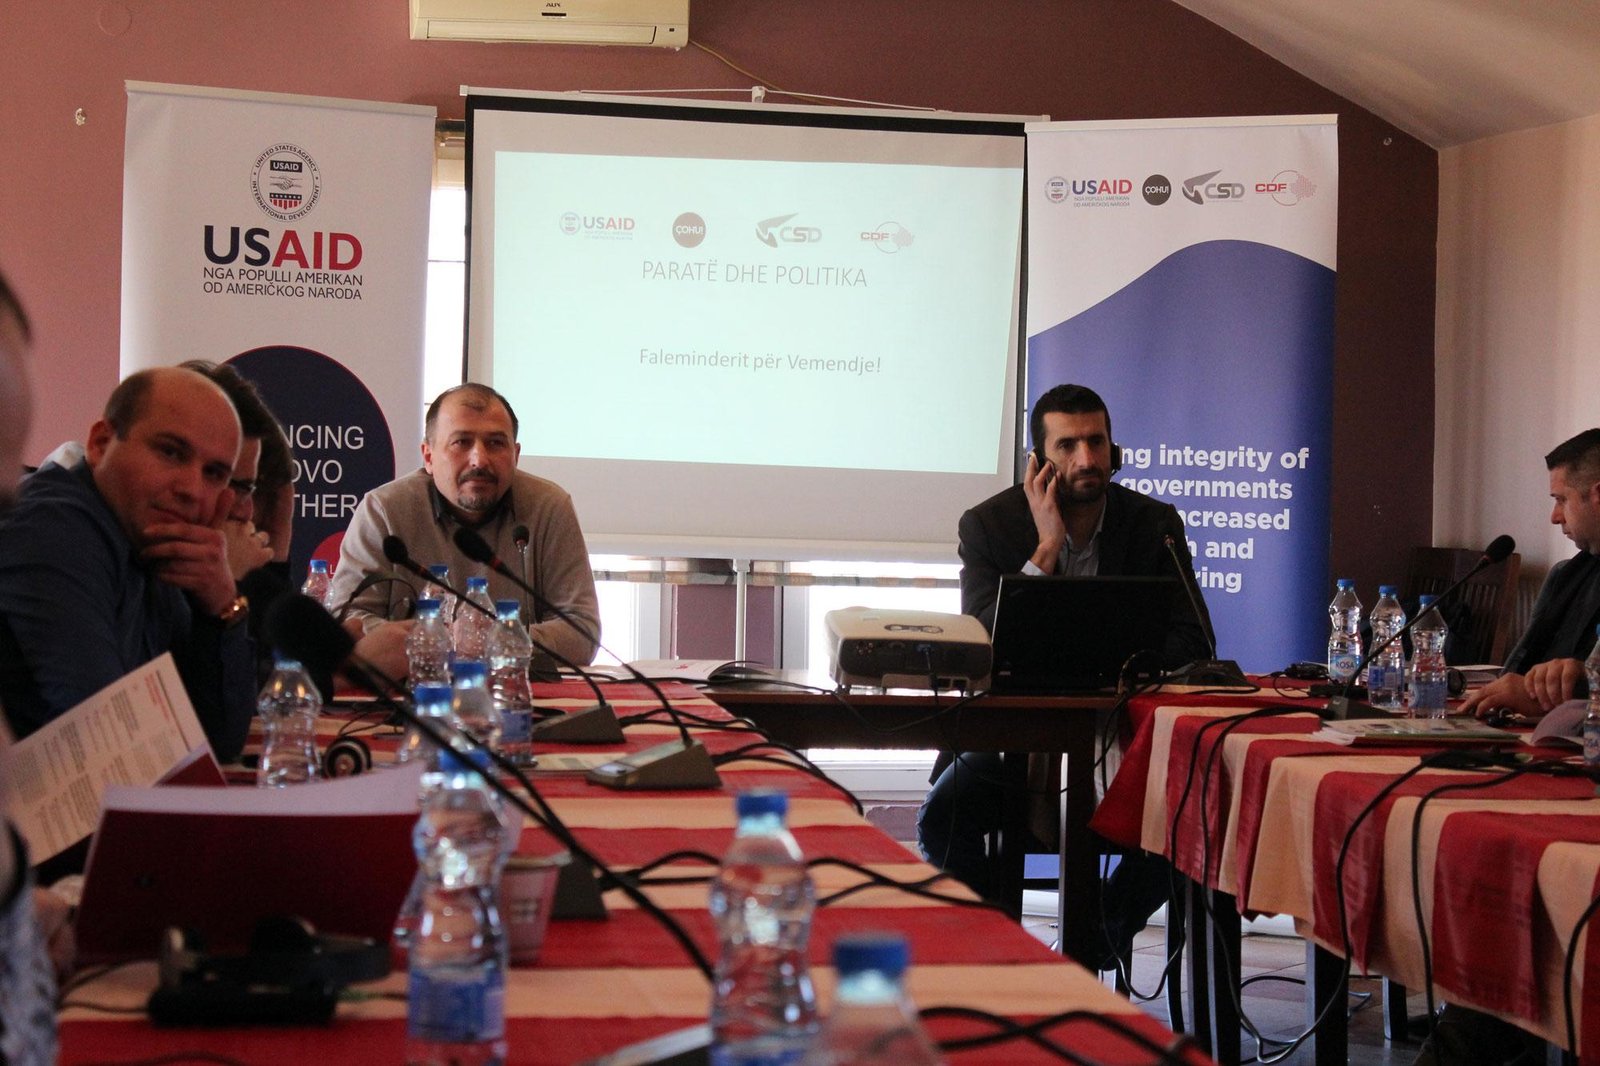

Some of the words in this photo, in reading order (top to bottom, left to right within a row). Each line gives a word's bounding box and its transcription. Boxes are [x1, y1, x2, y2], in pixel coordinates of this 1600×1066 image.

[256, 148, 274, 168] UNITED
[297, 150, 318, 172] AGENCY
[273, 162, 299, 170] USAID
[1072, 180, 1132, 194] USAID
[1205, 183, 1245, 199] CSD
[1256, 184, 1287, 192] CDF
[252, 181, 286, 220] INTERNATIONAL
[289, 186, 319, 220] DEVELOPMENT
[584, 216, 635, 231] USAID
[780, 226, 822, 243] CSD
[860, 232, 889, 240] CDF
[204, 225, 362, 270] USAID
[204, 267, 234, 280] NGA
[238, 269, 291, 282] POPULLI
[295, 272, 362, 286] AMERIKAN
[642, 258, 717, 282] PARATË
[725, 264, 767, 284] DHE
[776, 266, 867, 287] POLITIKA
[203, 282, 222, 293] OD
[226, 283, 304, 298] AMERIČKOG
[308, 287, 362, 300] NARODA
[640, 348, 748, 368] Faleminderit
[753, 354, 782, 372] për
[787, 354, 881, 376] Vemendje!
[1116, 444, 1151, 469] ng
[1160, 444, 1272, 472] integrity
[1280, 448, 1309, 469] of
[1205, 538, 1254, 559] and
